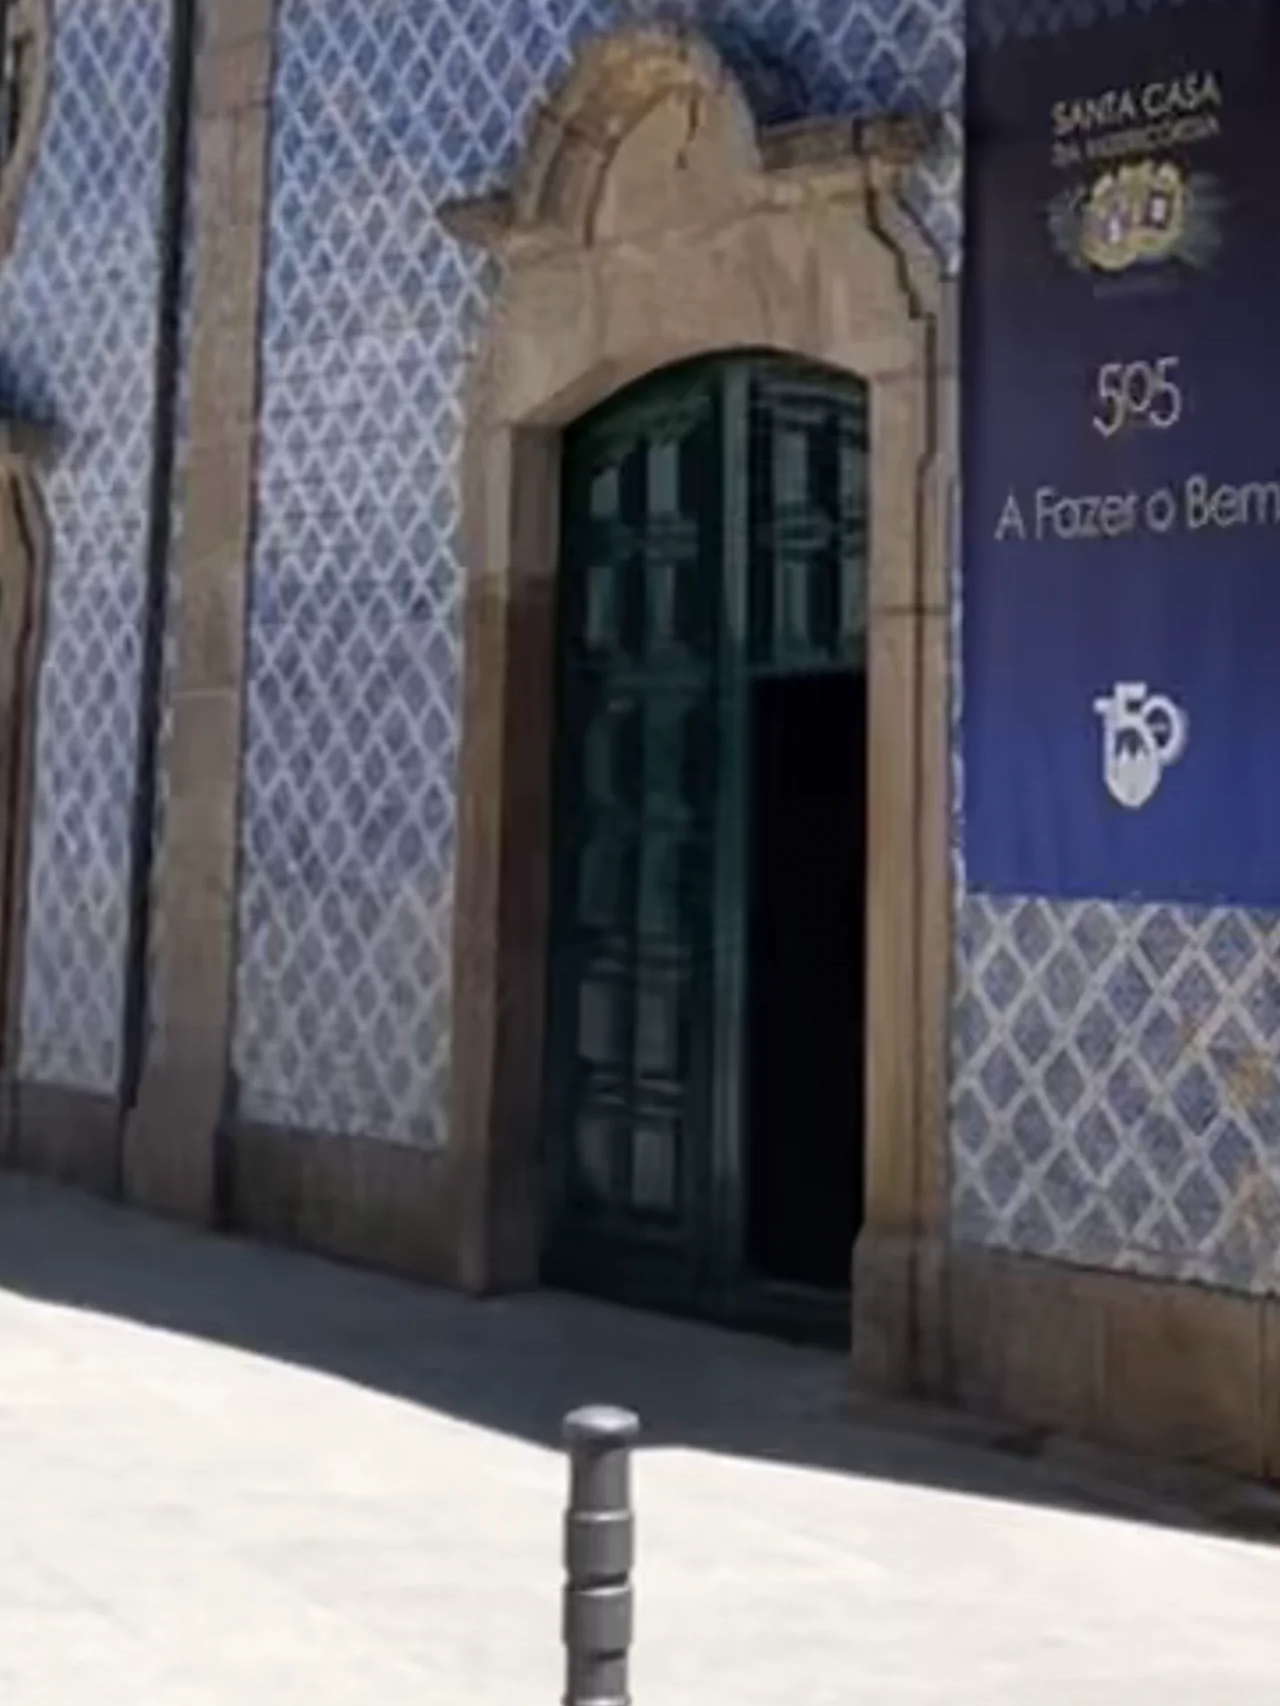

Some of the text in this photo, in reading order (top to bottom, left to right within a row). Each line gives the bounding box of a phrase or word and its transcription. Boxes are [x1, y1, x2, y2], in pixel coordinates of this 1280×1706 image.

[1051, 70, 1222, 136] SANTA CASA
[1093, 356, 1182, 438] 505
[994, 491, 1027, 540] A
[1035, 486, 1138, 540] Fazer
[1145, 490, 1177, 532] o
